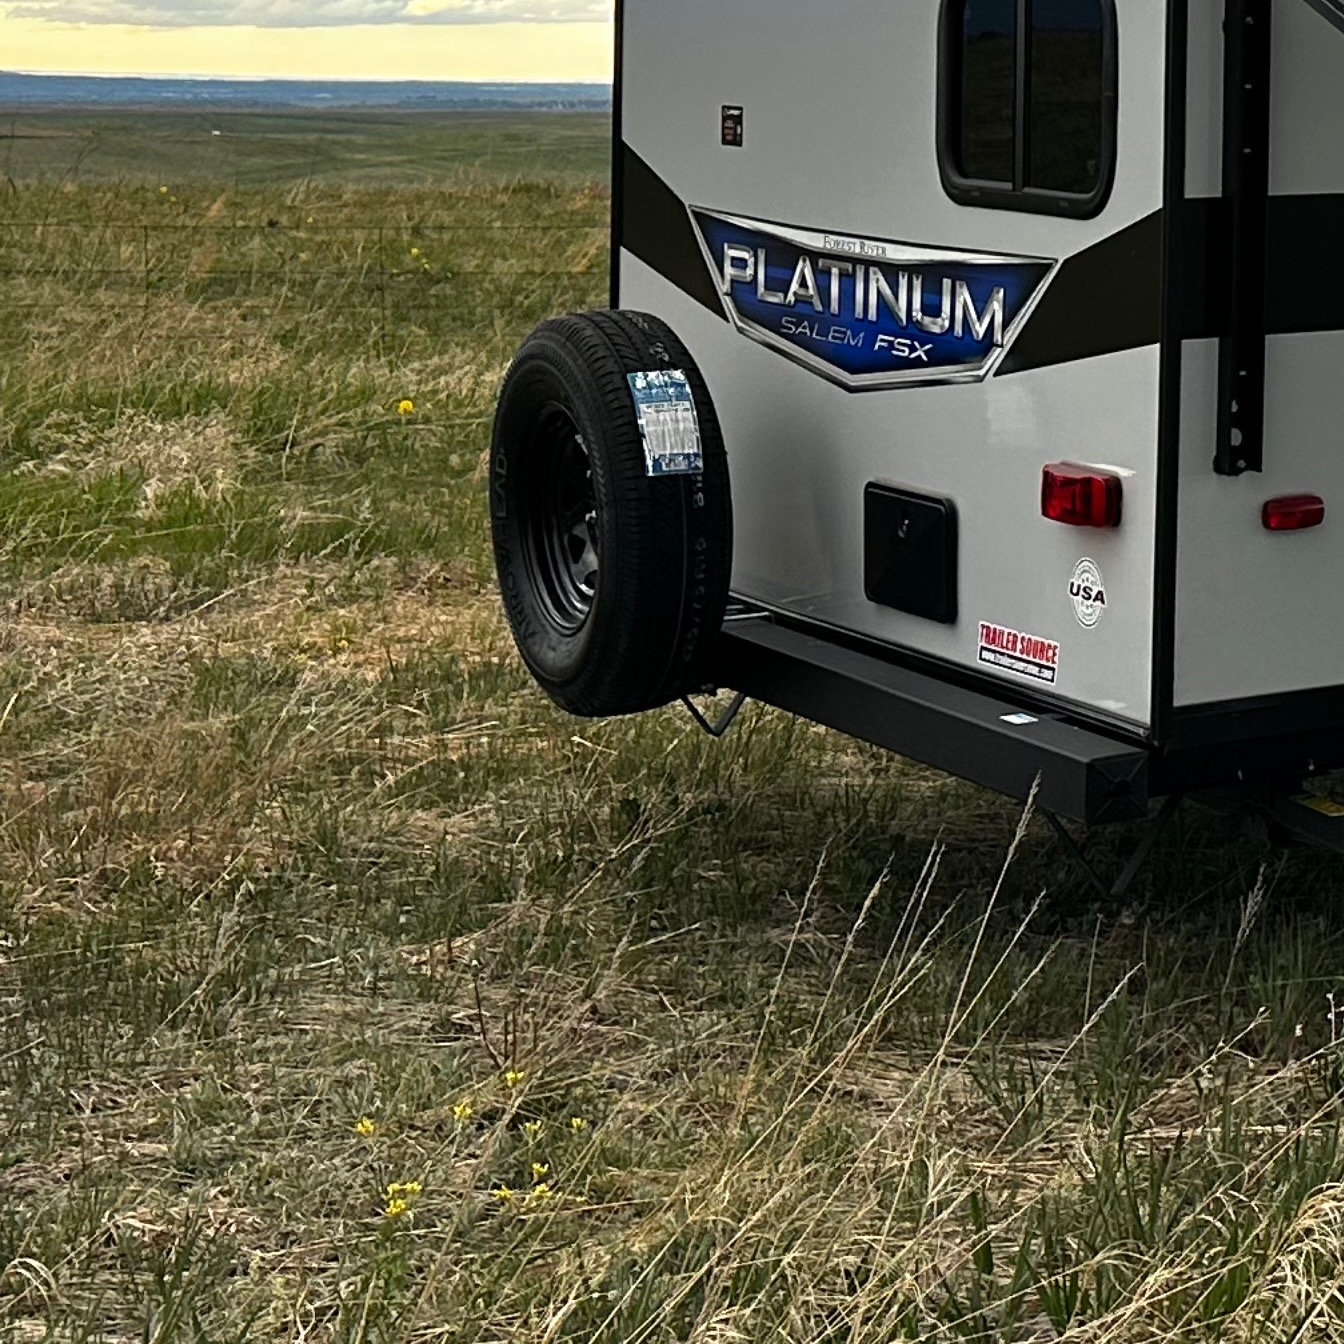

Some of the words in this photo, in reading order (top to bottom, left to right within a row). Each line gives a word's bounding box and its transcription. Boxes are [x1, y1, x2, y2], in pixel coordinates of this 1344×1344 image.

[823, 235, 856, 251] FOREST
[859, 240, 887, 257] RIVER
[722, 242, 1006, 348] PLATINUM
[779, 316, 866, 349] SALEM
[873, 334, 934, 362] FSX
[1069, 581, 1106, 606] USA
[980, 623, 1018, 653] TRAILER
[1019, 635, 1058, 664] SOURCE
